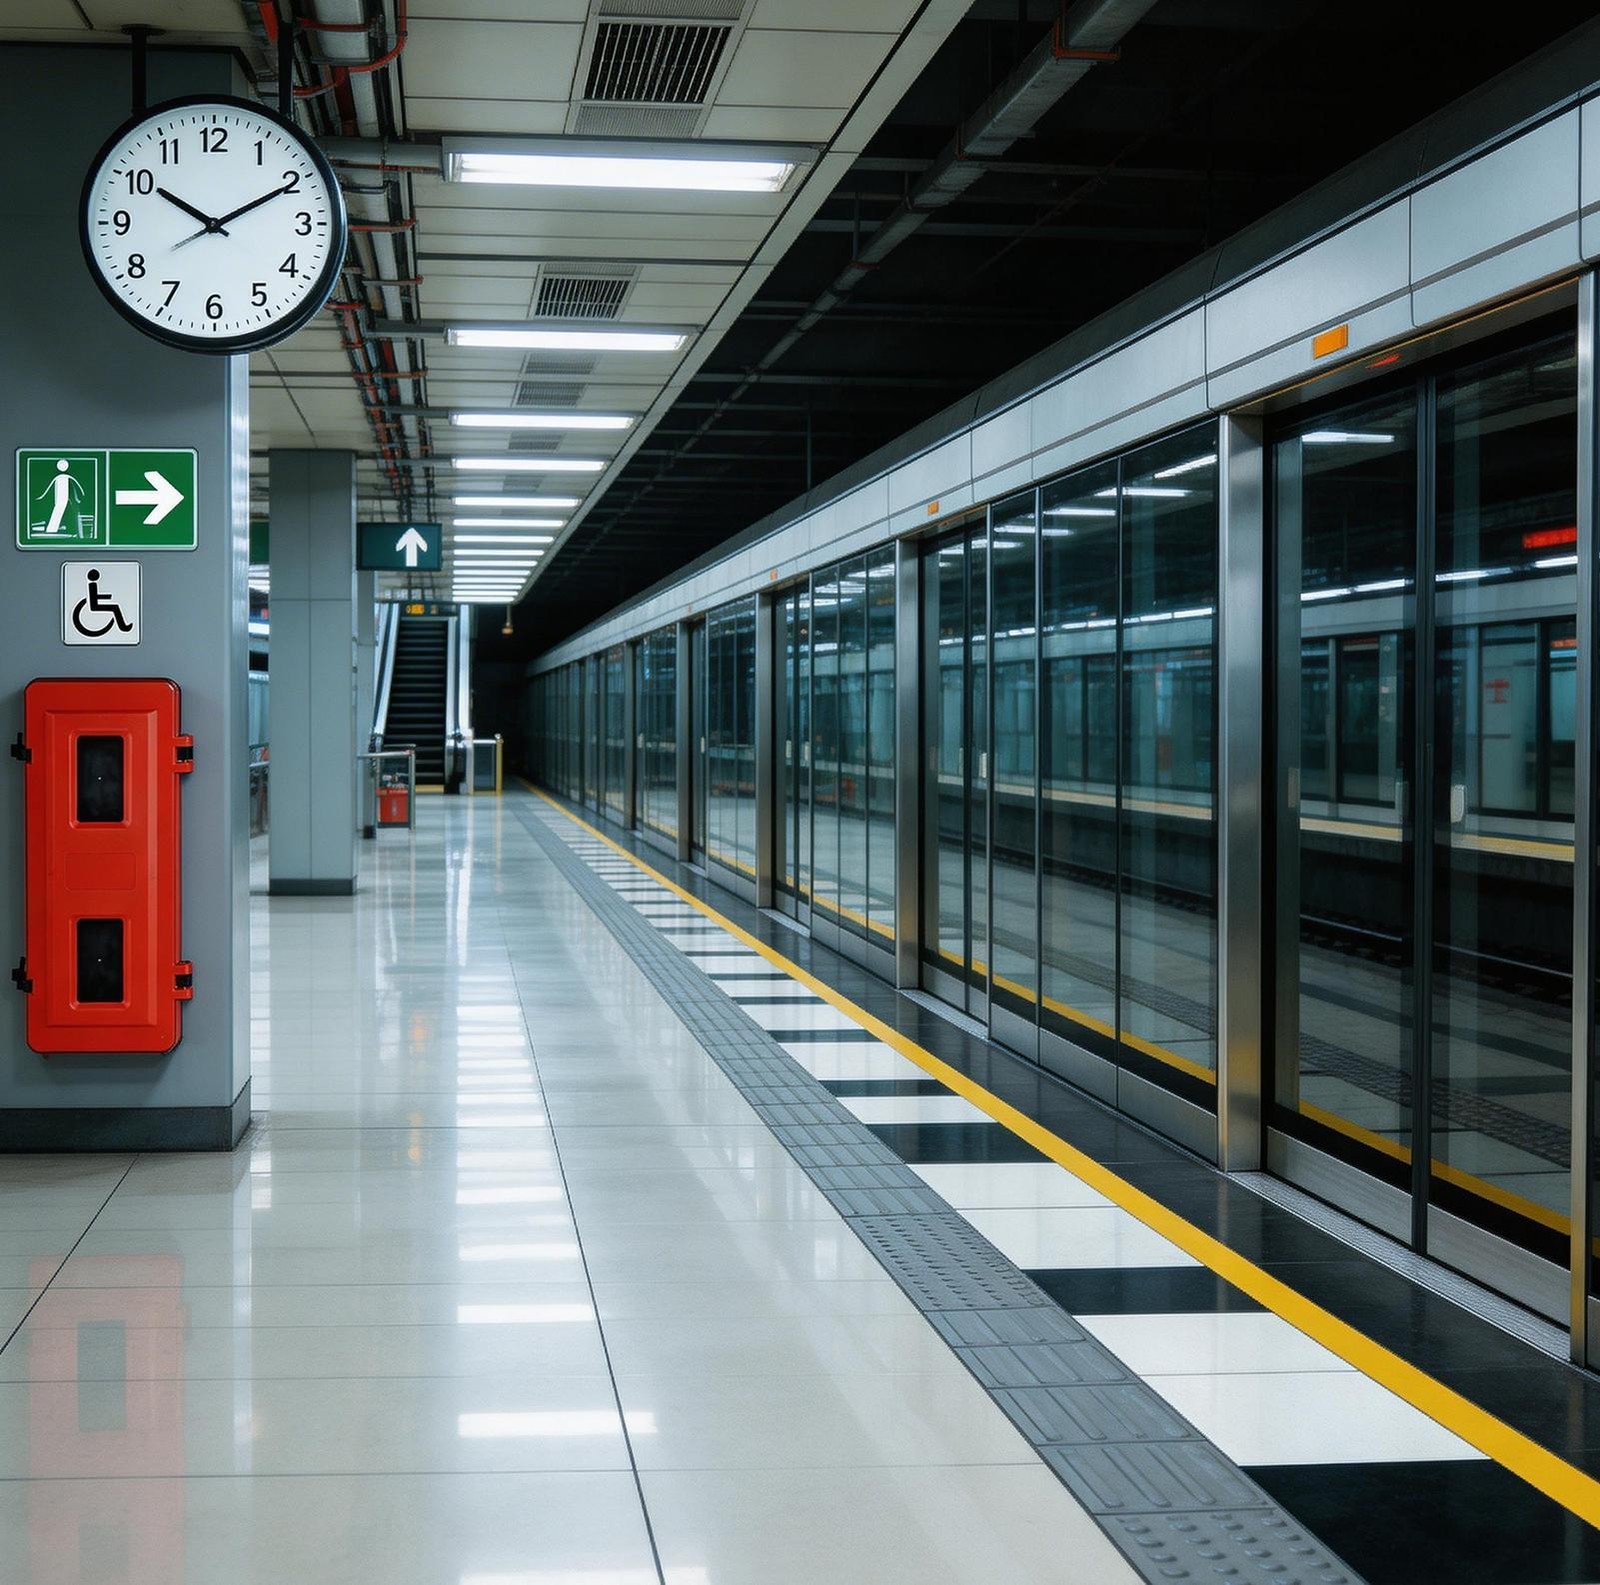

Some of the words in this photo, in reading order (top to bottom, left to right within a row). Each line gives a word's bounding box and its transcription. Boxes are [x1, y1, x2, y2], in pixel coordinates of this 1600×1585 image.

[160, 139, 178, 164] 11
[200, 127, 228, 152] 12
[254, 141, 262, 165] 1
[126, 169, 153, 195] 10
[282, 171, 300, 194] 2
[113, 211, 130, 235] 9
[295, 212, 312, 235] 3
[128, 254, 145, 278] 8
[279, 253, 298, 278] 4
[162, 281, 180, 307] 7
[251, 283, 267, 306] 5
[206, 294, 223, 319] 6
